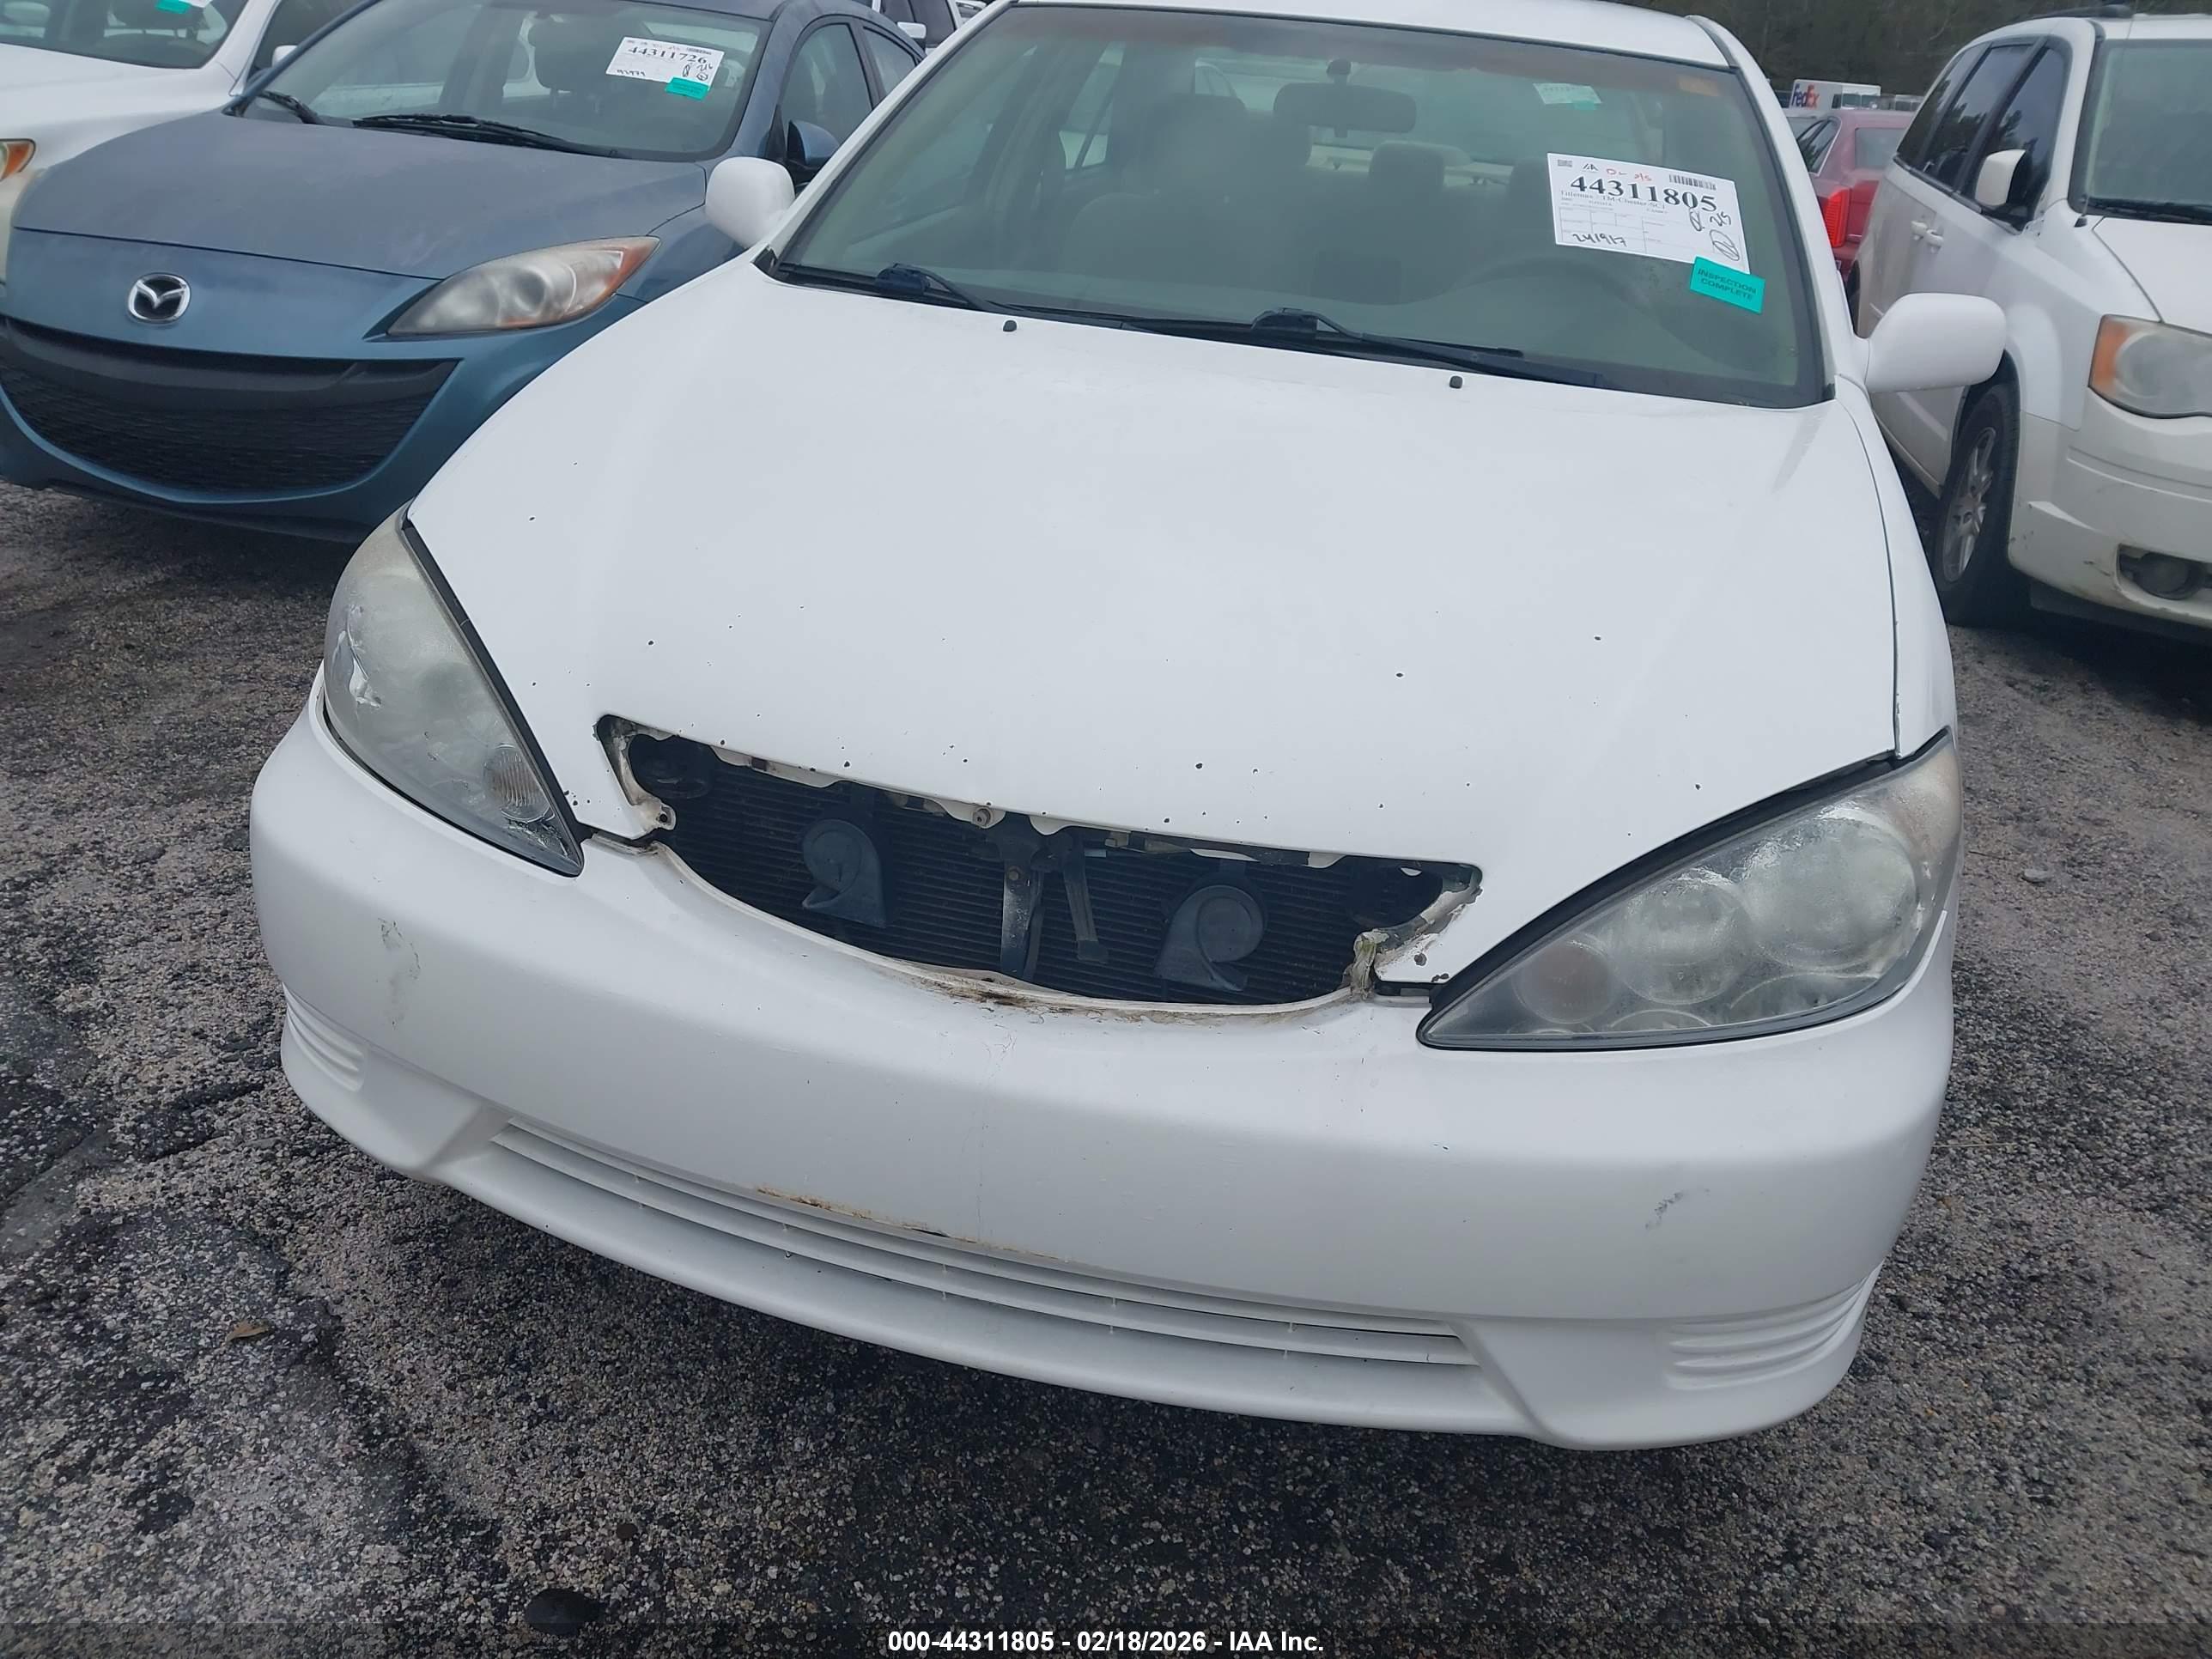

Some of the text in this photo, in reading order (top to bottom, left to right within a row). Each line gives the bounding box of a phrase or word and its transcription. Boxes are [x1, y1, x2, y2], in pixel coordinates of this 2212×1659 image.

[628, 46, 708, 64] 44311726
[1792, 83, 1820, 108] FedEx
[1571, 175, 1717, 212] 44311805
[1698, 268, 1757, 294] INSPECTION
[1701, 278, 1753, 300] COMPLETE
